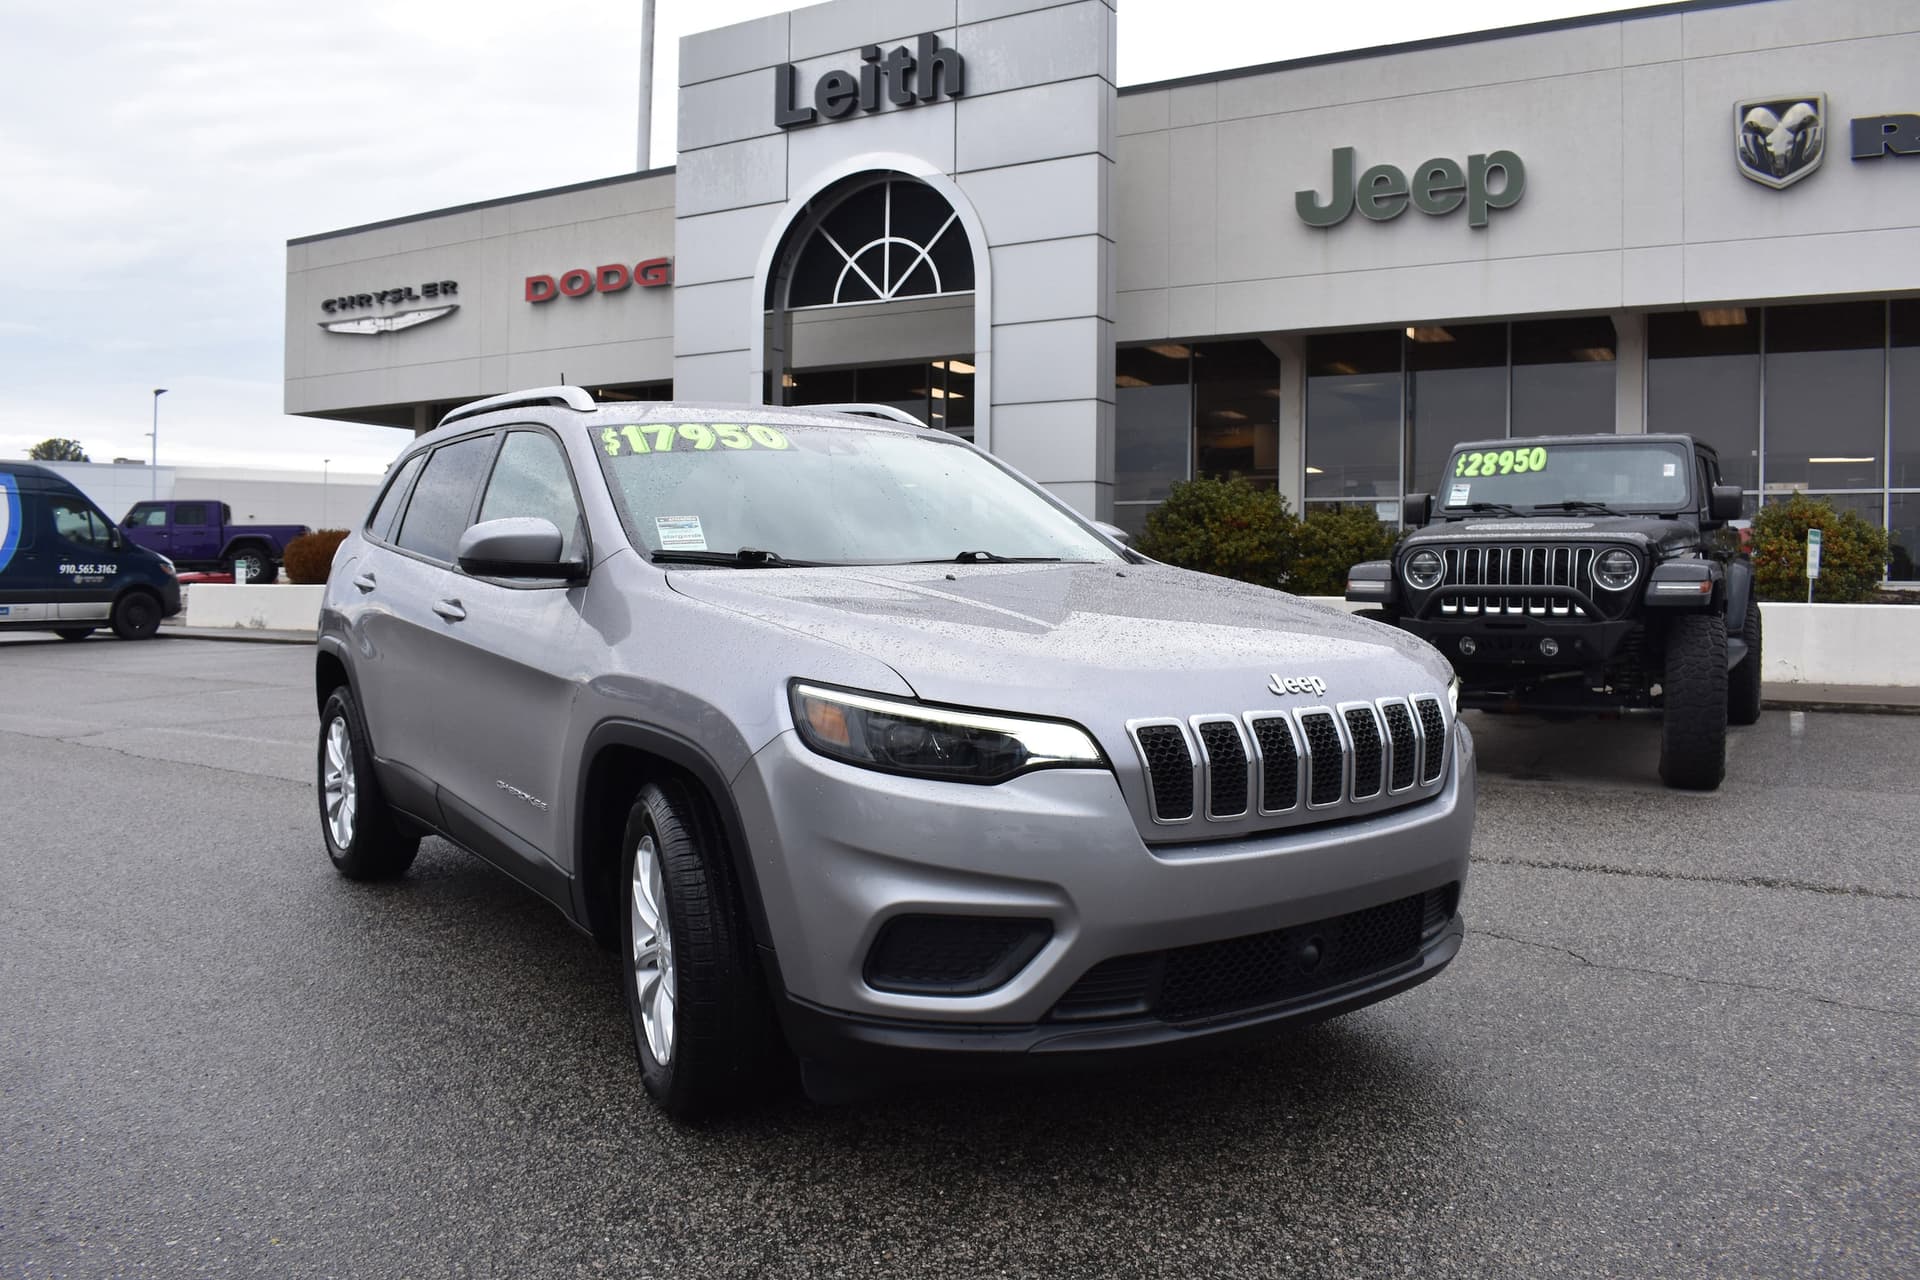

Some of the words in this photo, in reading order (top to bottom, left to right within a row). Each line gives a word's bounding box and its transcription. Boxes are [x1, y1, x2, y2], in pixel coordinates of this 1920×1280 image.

[775, 32, 965, 128] Leith
[1295, 146, 1527, 228] Jeep
[525, 255, 675, 302] DODG
[321, 280, 459, 313] CHRYSLER
[601, 423, 788, 456] $17950
[1455, 446, 1547, 477] $28950
[59, 564, 118, 574] 910.565.3162
[1267, 673, 1327, 697] Jeep
